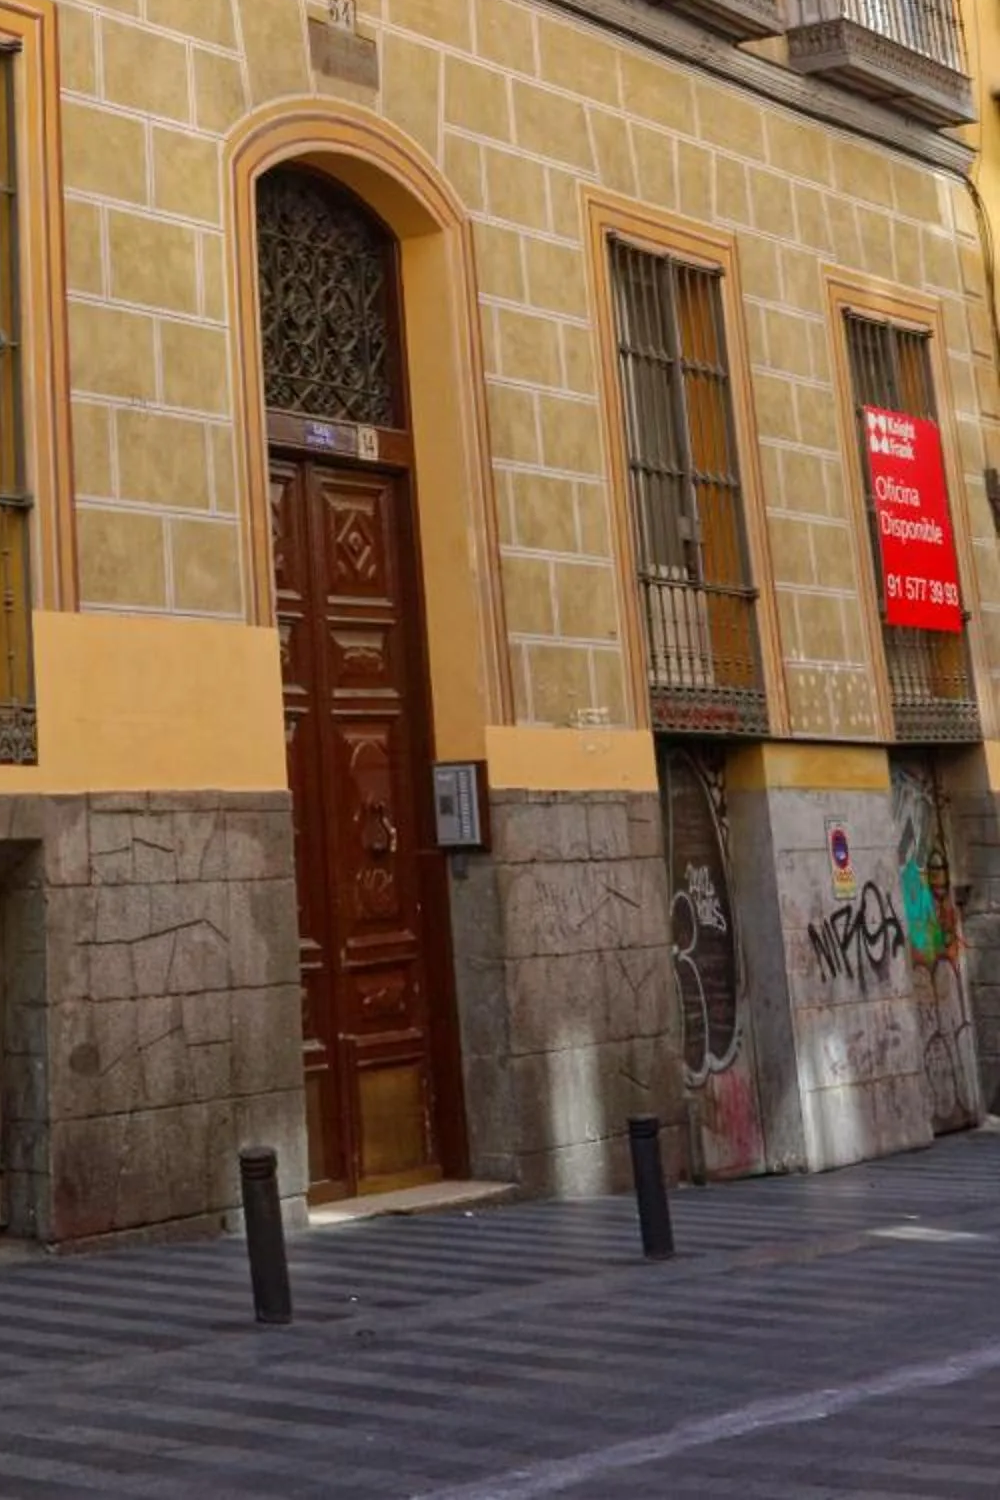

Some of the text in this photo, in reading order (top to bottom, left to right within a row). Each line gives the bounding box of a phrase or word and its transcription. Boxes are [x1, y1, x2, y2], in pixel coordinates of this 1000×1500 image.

[875, 475, 920, 508] Oficina
[880, 509, 944, 546] Disponible
[887, 572, 903, 598] 91
[905, 575, 927, 601] 577
